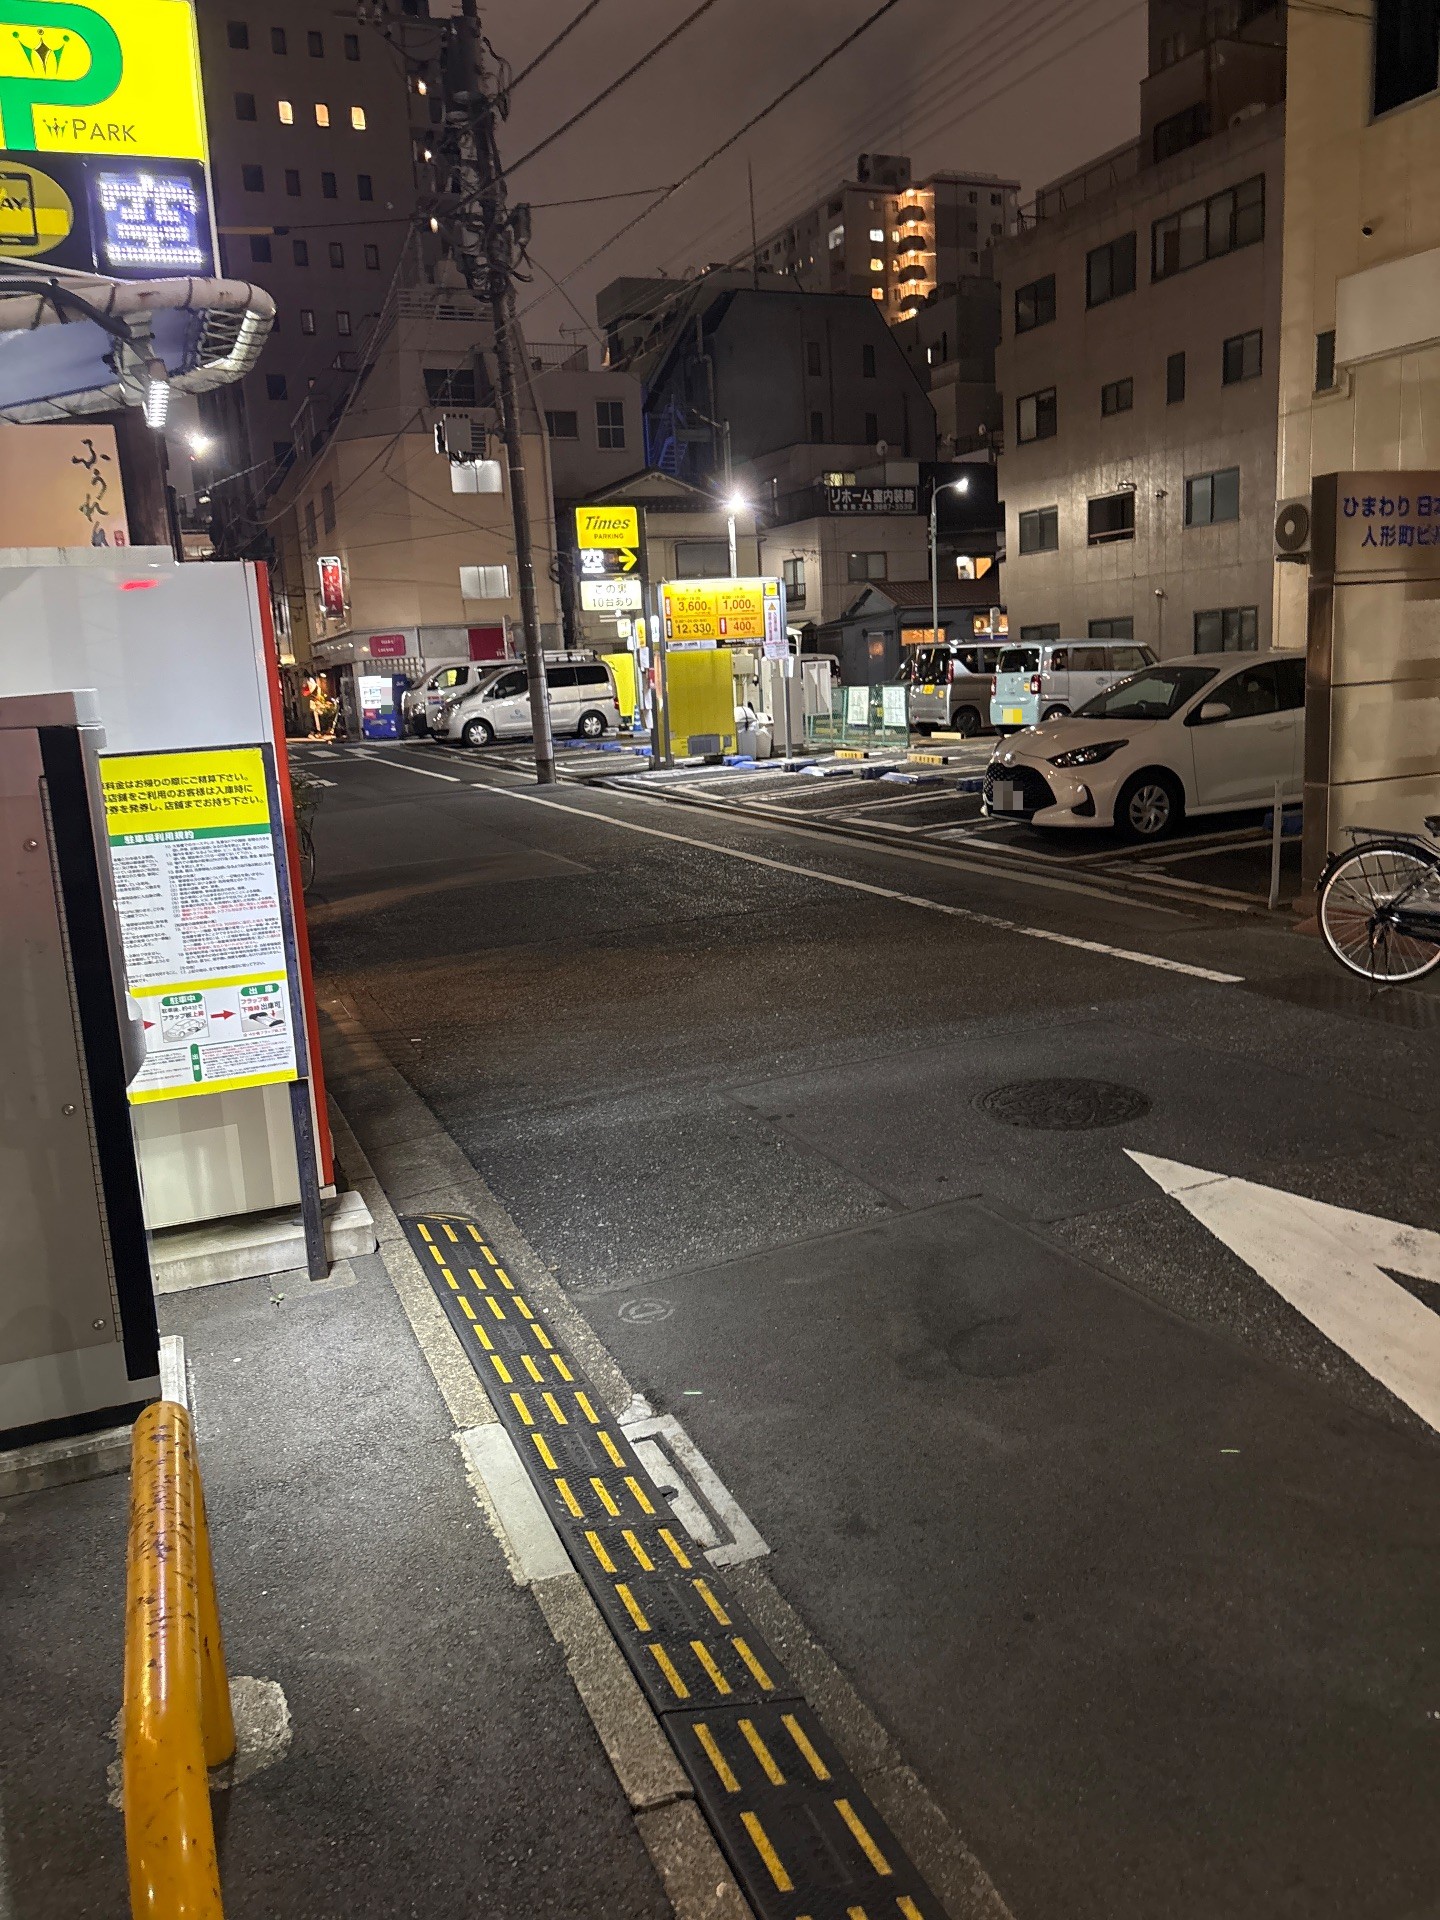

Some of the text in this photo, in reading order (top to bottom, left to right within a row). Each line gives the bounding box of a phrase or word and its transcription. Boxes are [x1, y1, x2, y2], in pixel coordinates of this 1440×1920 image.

[72, 118, 137, 143] PARK
[99, 173, 204, 264] 空
[1343, 496, 1411, 517] ひまわり
[585, 516, 630, 530] Times
[592, 597, 633, 608] 10台あり
[124, 830, 195, 844] 駐車場利用規約
[169, 995, 197, 1005] 駐車中
